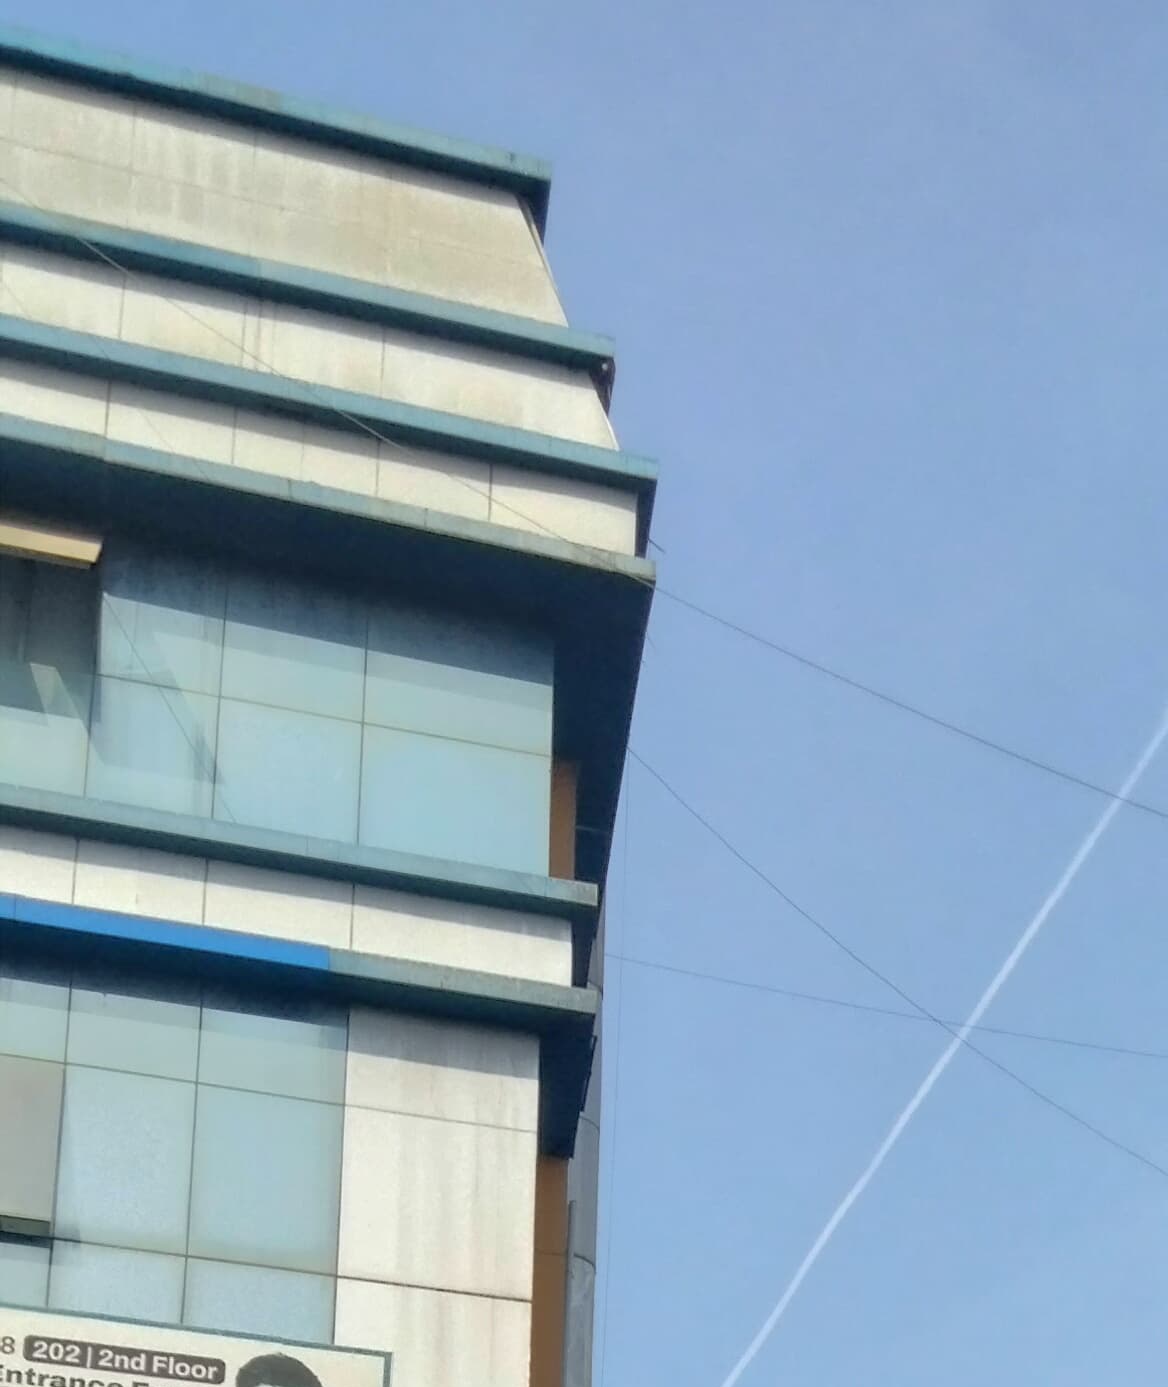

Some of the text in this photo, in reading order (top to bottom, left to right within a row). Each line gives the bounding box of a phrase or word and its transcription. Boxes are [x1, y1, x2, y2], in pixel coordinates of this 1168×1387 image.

[32, 1340, 219, 1380] 202 2nd Floor
